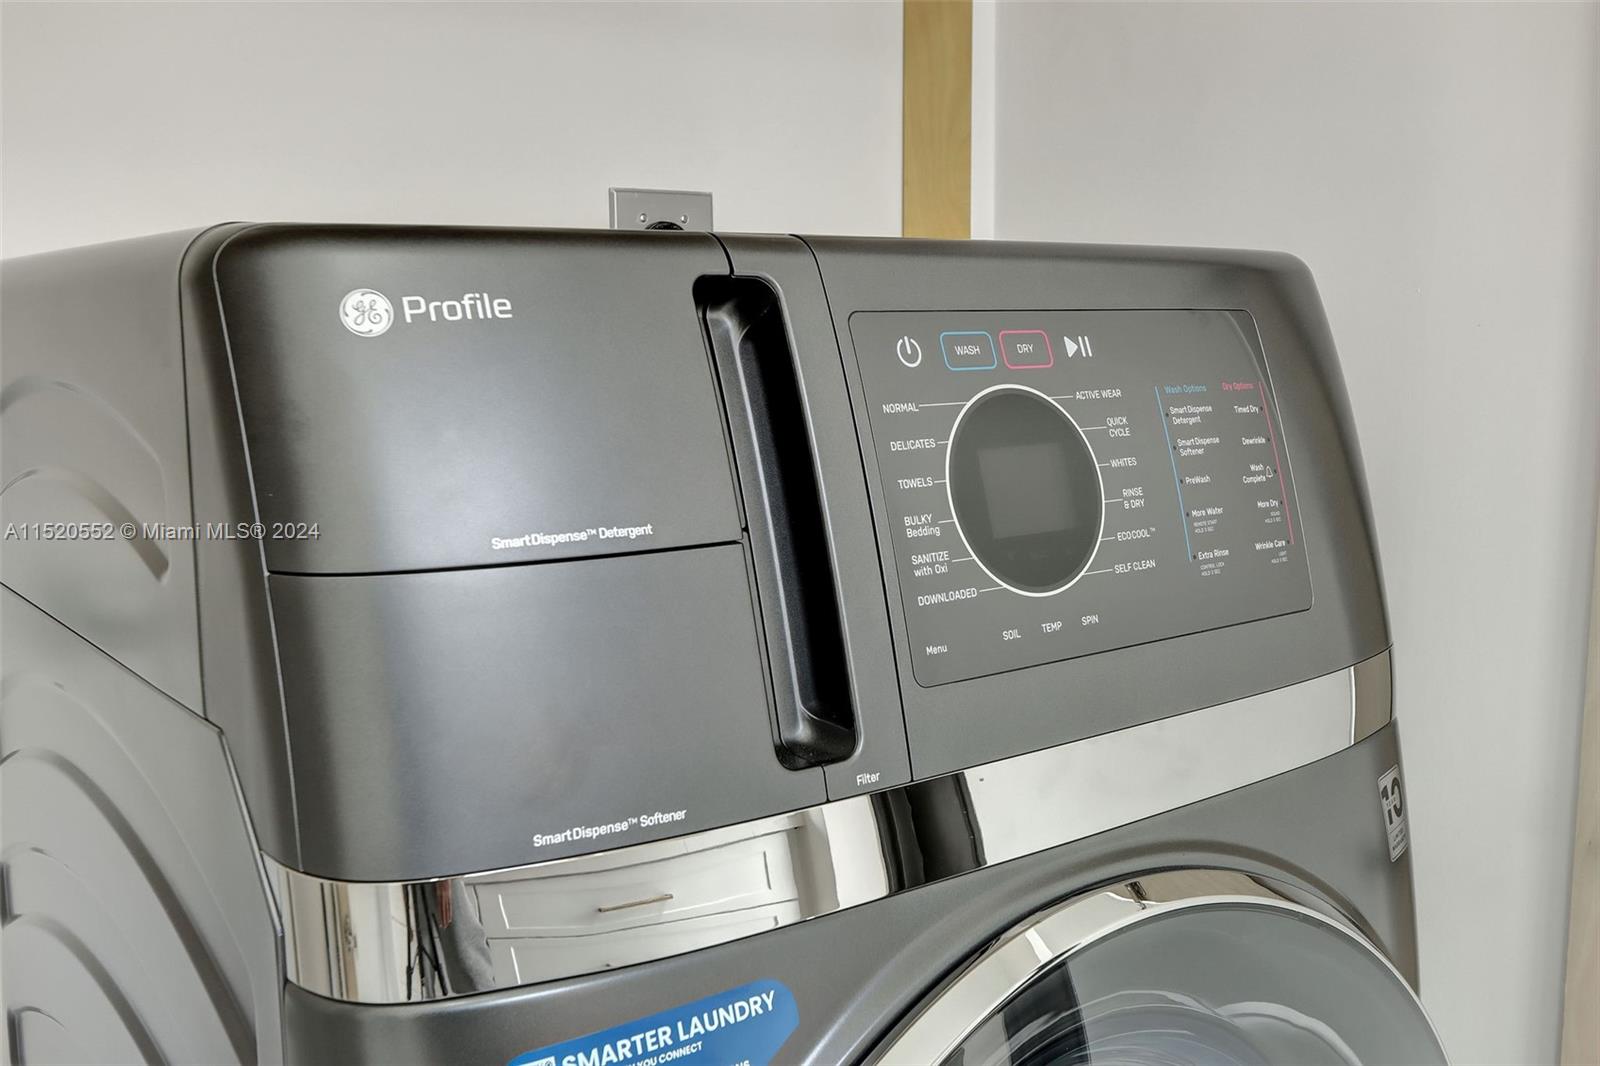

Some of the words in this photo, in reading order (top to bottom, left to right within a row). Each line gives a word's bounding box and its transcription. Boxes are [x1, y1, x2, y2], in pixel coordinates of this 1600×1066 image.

[402, 293, 512, 323] Profile
[954, 345, 981, 356] WASH
[1016, 343, 1034, 354] DRY
[1165, 385, 1183, 394] Wash
[1184, 384, 1207, 394] Options
[1222, 382, 1232, 391] Dry
[1075, 390, 1100, 400] ACTIVE
[1100, 389, 1122, 399] WEAR
[882, 402, 919, 414] NORMAL
[1234, 405, 1249, 414] Timed
[1250, 404, 1259, 415] Dry
[1106, 416, 1129, 427] QUICK
[1172, 415, 1202, 426] Detergent
[1109, 427, 1131, 438] CYCLE
[890, 438, 936, 451] DELICATES
[1180, 447, 1205, 457] Softener
[1110, 457, 1137, 468] WHITES
[1250, 463, 1264, 472] Wash
[897, 477, 933, 489] TOWELS
[1185, 475, 1211, 485] PreWash
[1242, 474, 1266, 485] Complete
[1122, 486, 1144, 498] RINSE
[1123, 500, 1130, 510] &
[1130, 498, 1145, 509] DRY
[1257, 500, 1270, 509] More
[1270, 498, 1279, 508] Dry
[1191, 508, 1206, 518] More
[1207, 506, 1224, 516] Water
[904, 514, 933, 527] BULKY
[598, 523, 653, 540] Detergent
[906, 525, 941, 539] Bedding
[1255, 541, 1274, 551] Wrinkle
[1274, 539, 1286, 548] Care
[911, 551, 950, 566] SANITIZE
[1198, 551, 1214, 560] Extra
[1214, 549, 1230, 558] Rinse
[914, 565, 934, 577] with
[934, 563, 948, 575] Oxi
[1114, 562, 1132, 574] SELF
[1132, 559, 1156, 571] CLEAN
[917, 588, 978, 607] DOWNLOADED
[1081, 614, 1100, 626] SPIN
[1041, 621, 1063, 634] TEMP
[1002, 629, 1022, 641] SOIL
[926, 643, 948, 656] Menu
[856, 770, 881, 787] Filter
[1381, 777, 1403, 826] 10
[639, 808, 687, 828] Softener
[561, 1028, 672, 1066] SMARTER
[677, 990, 776, 1042] LAUNDRY
[658, 1041, 703, 1064] CONNECT
